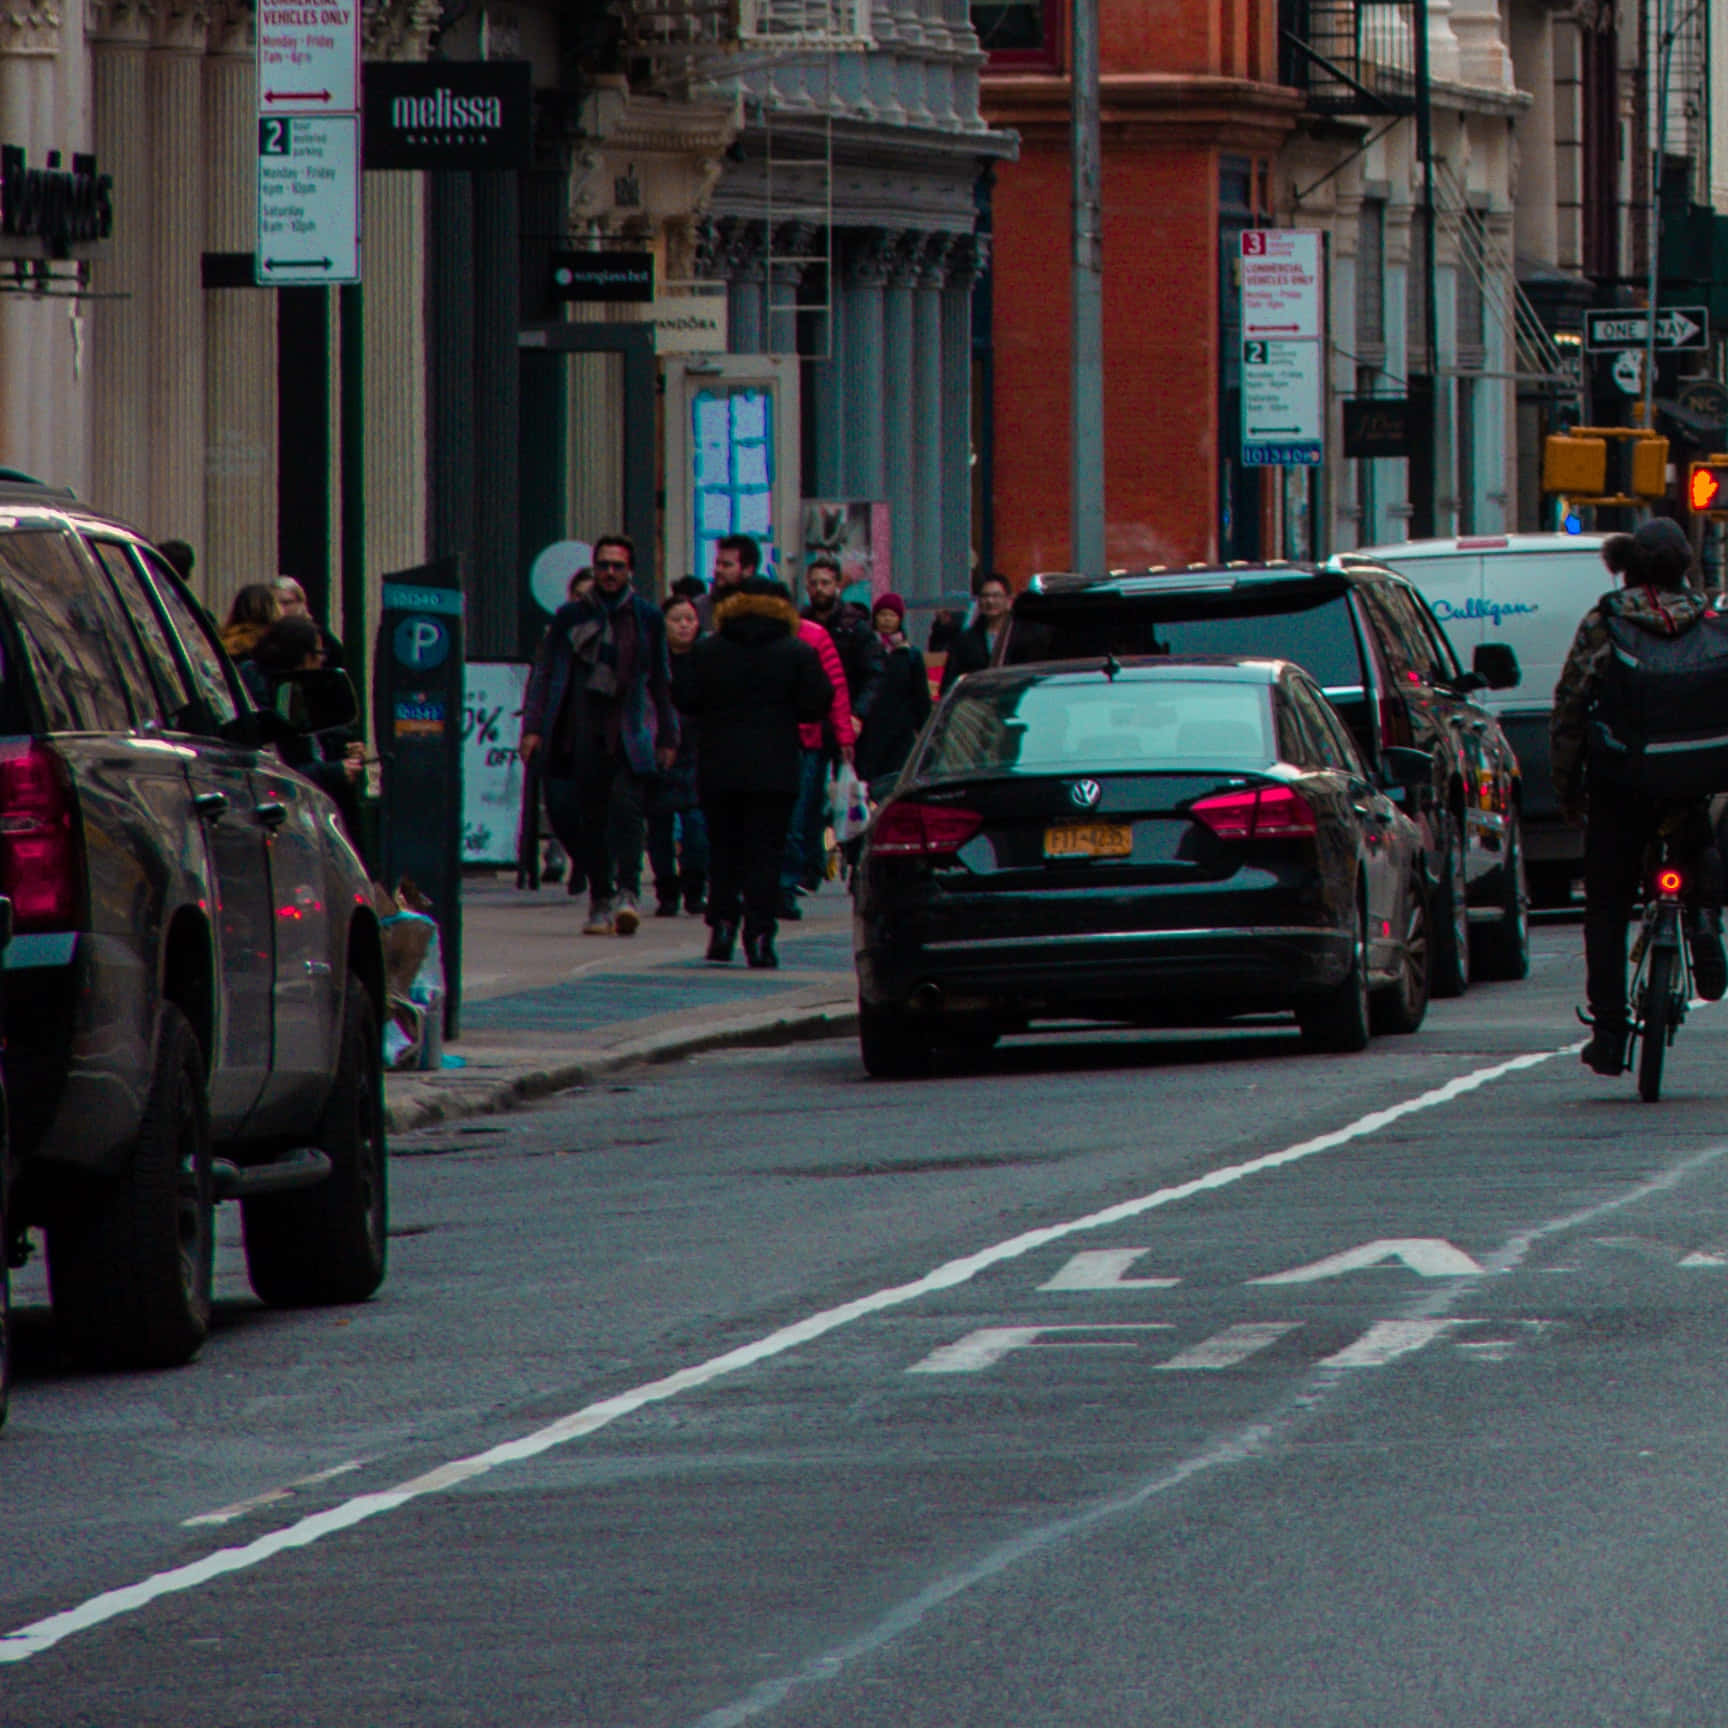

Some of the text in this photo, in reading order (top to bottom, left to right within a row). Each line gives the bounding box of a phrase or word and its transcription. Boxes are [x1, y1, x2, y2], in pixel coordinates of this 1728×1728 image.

[262, 9, 351, 26] VEHICLES ONLY
[262, 34, 335, 51] Monday Friday
[392, 87, 503, 129] melissa
[265, 120, 285, 154] 2
[1602, 323, 1637, 339] ONE
[1431, 597, 1535, 627] Culligan
[411, 620, 442, 663] P
